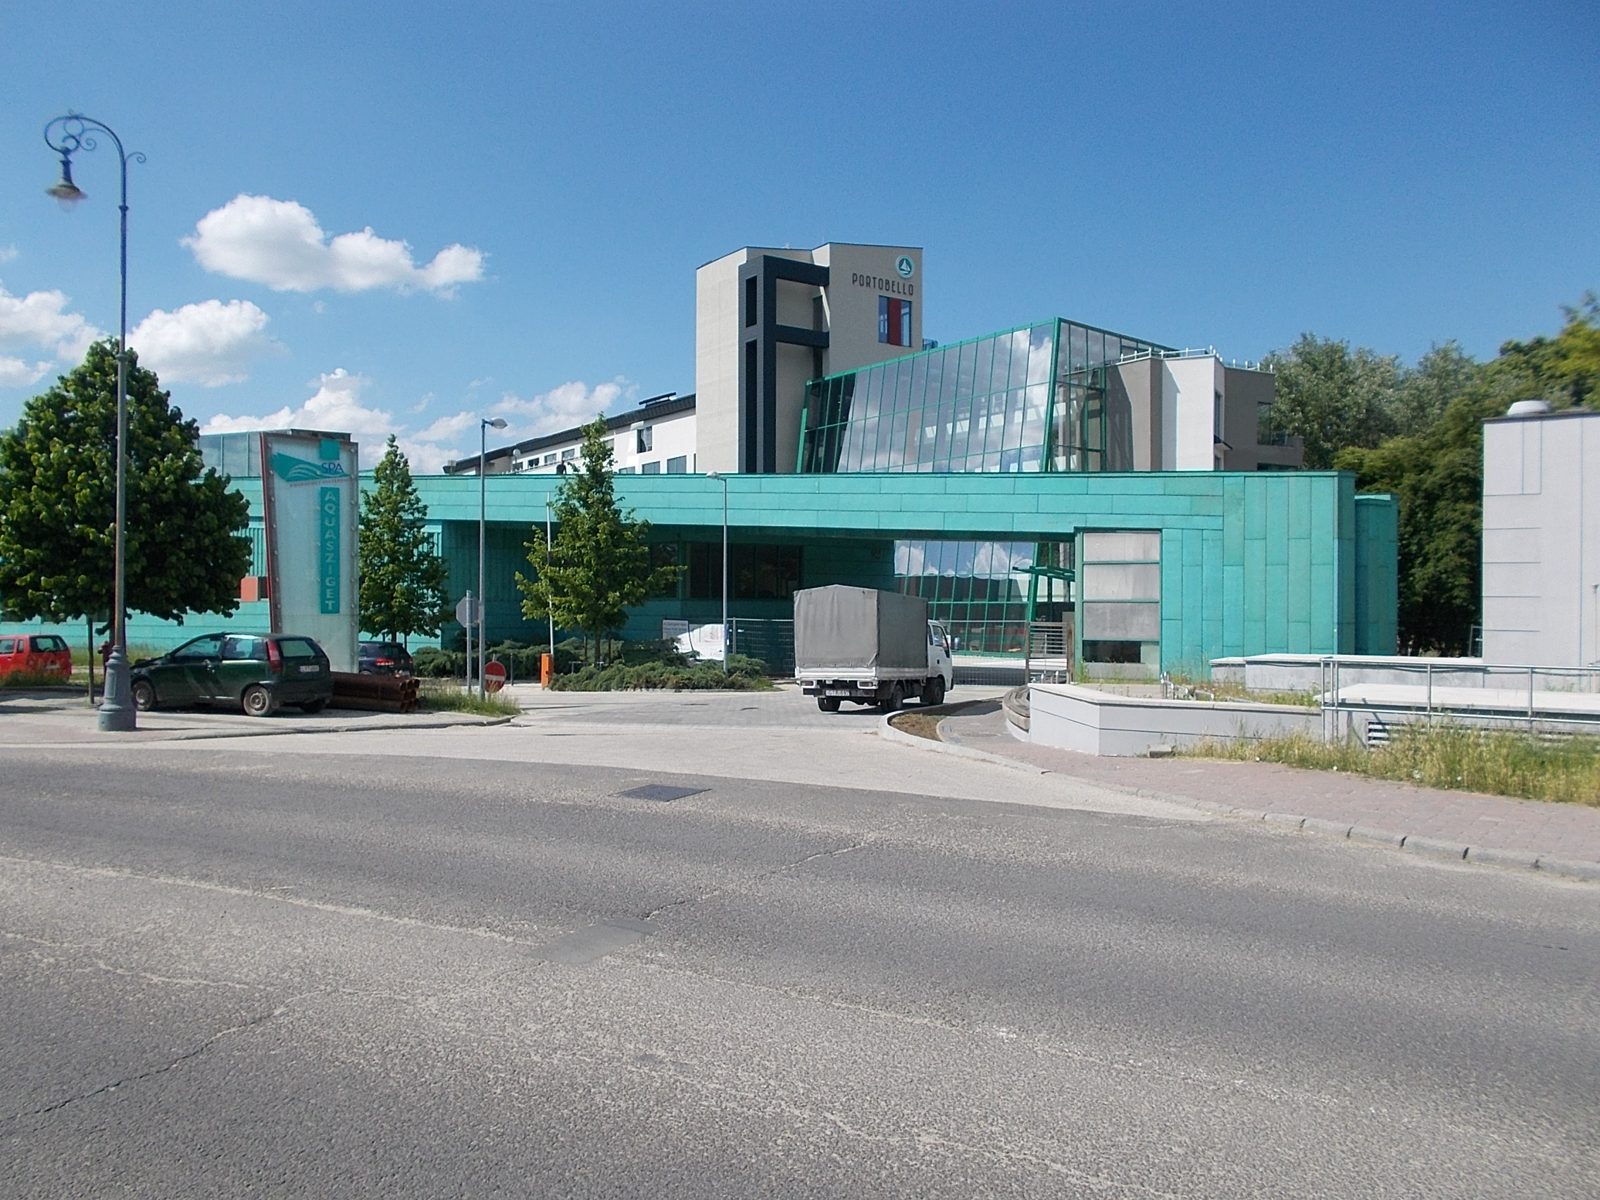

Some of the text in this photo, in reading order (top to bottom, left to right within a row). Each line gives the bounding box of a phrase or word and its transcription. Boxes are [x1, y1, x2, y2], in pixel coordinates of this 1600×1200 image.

[851, 272, 914, 296] PORTOBELLO
[321, 462, 345, 474] SPA
[324, 490, 337, 611] AQUASZIGET
